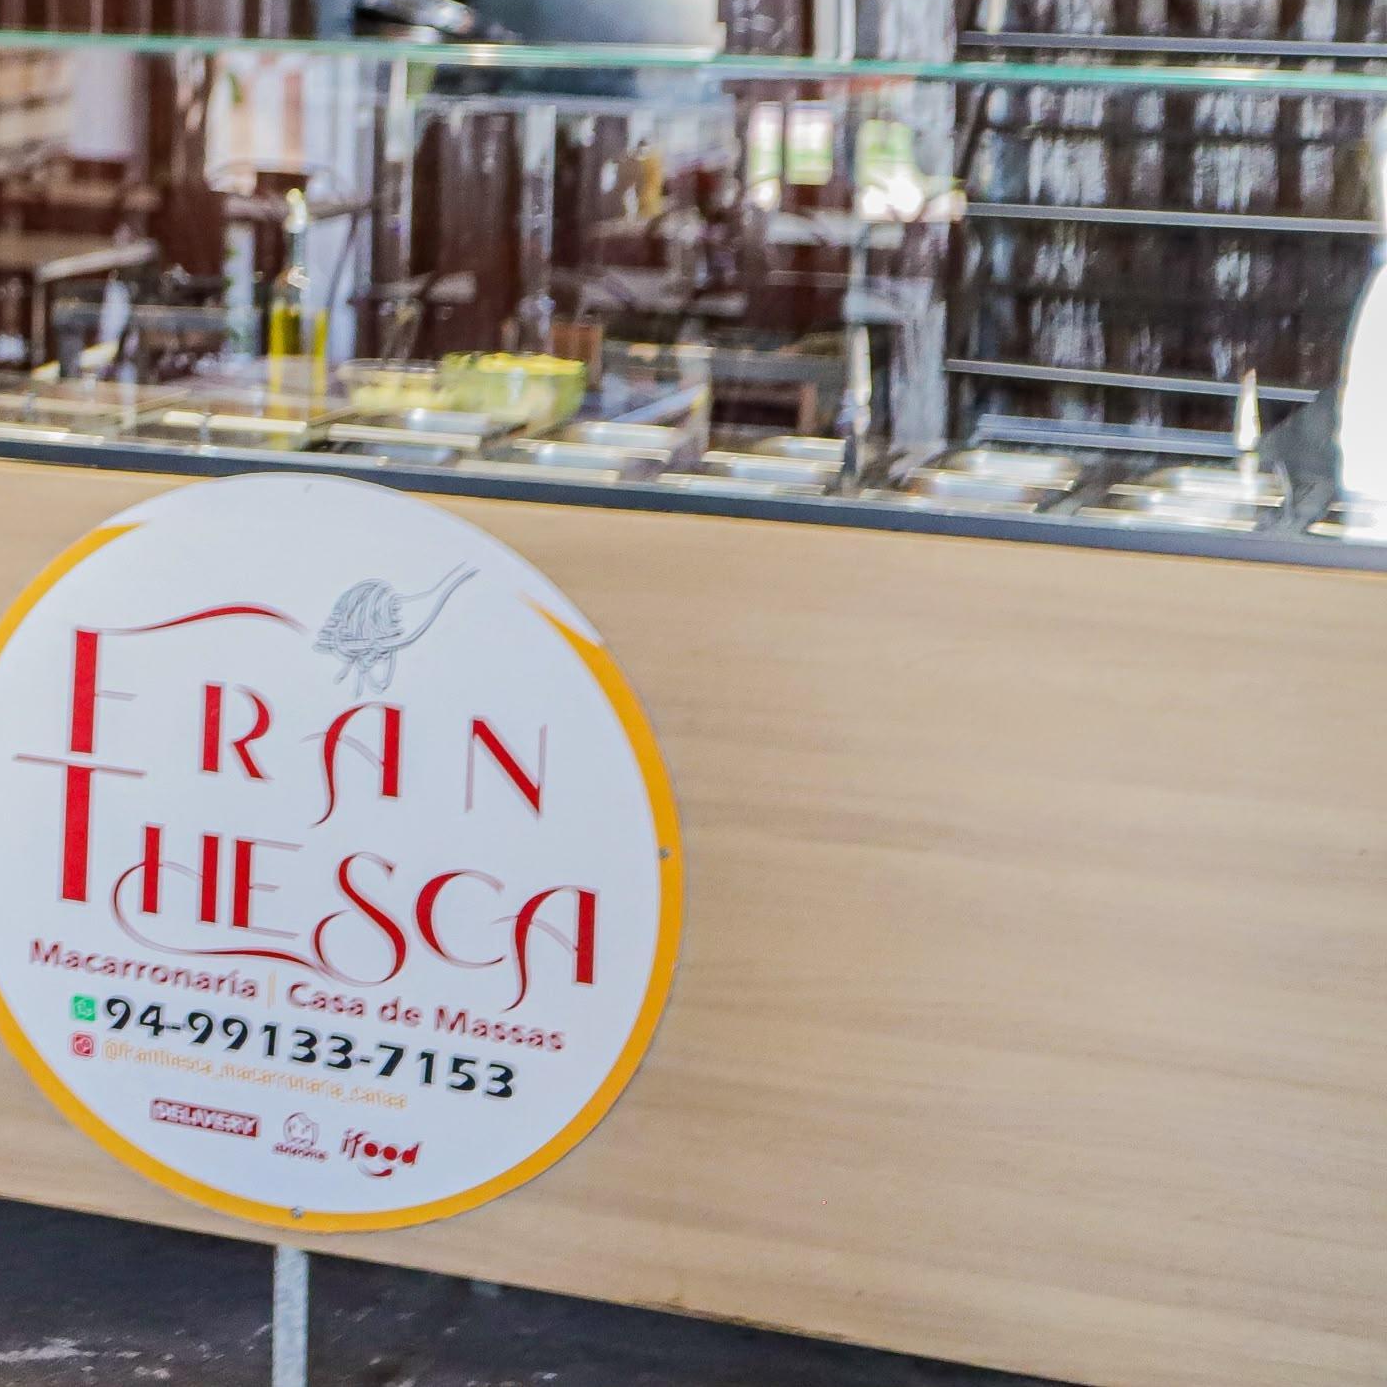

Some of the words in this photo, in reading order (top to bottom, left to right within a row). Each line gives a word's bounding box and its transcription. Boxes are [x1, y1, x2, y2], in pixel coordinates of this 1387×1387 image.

[67, 601, 548, 828] FRAN
[12, 752, 599, 1012] THESCA
[104, 996, 517, 1100] 94-99133-7153
[286, 980, 369, 1018] Casa
[378, 996, 423, 1028] de
[433, 1005, 568, 1054] Massas
[151, 1099, 260, 1137] DELIVERY
